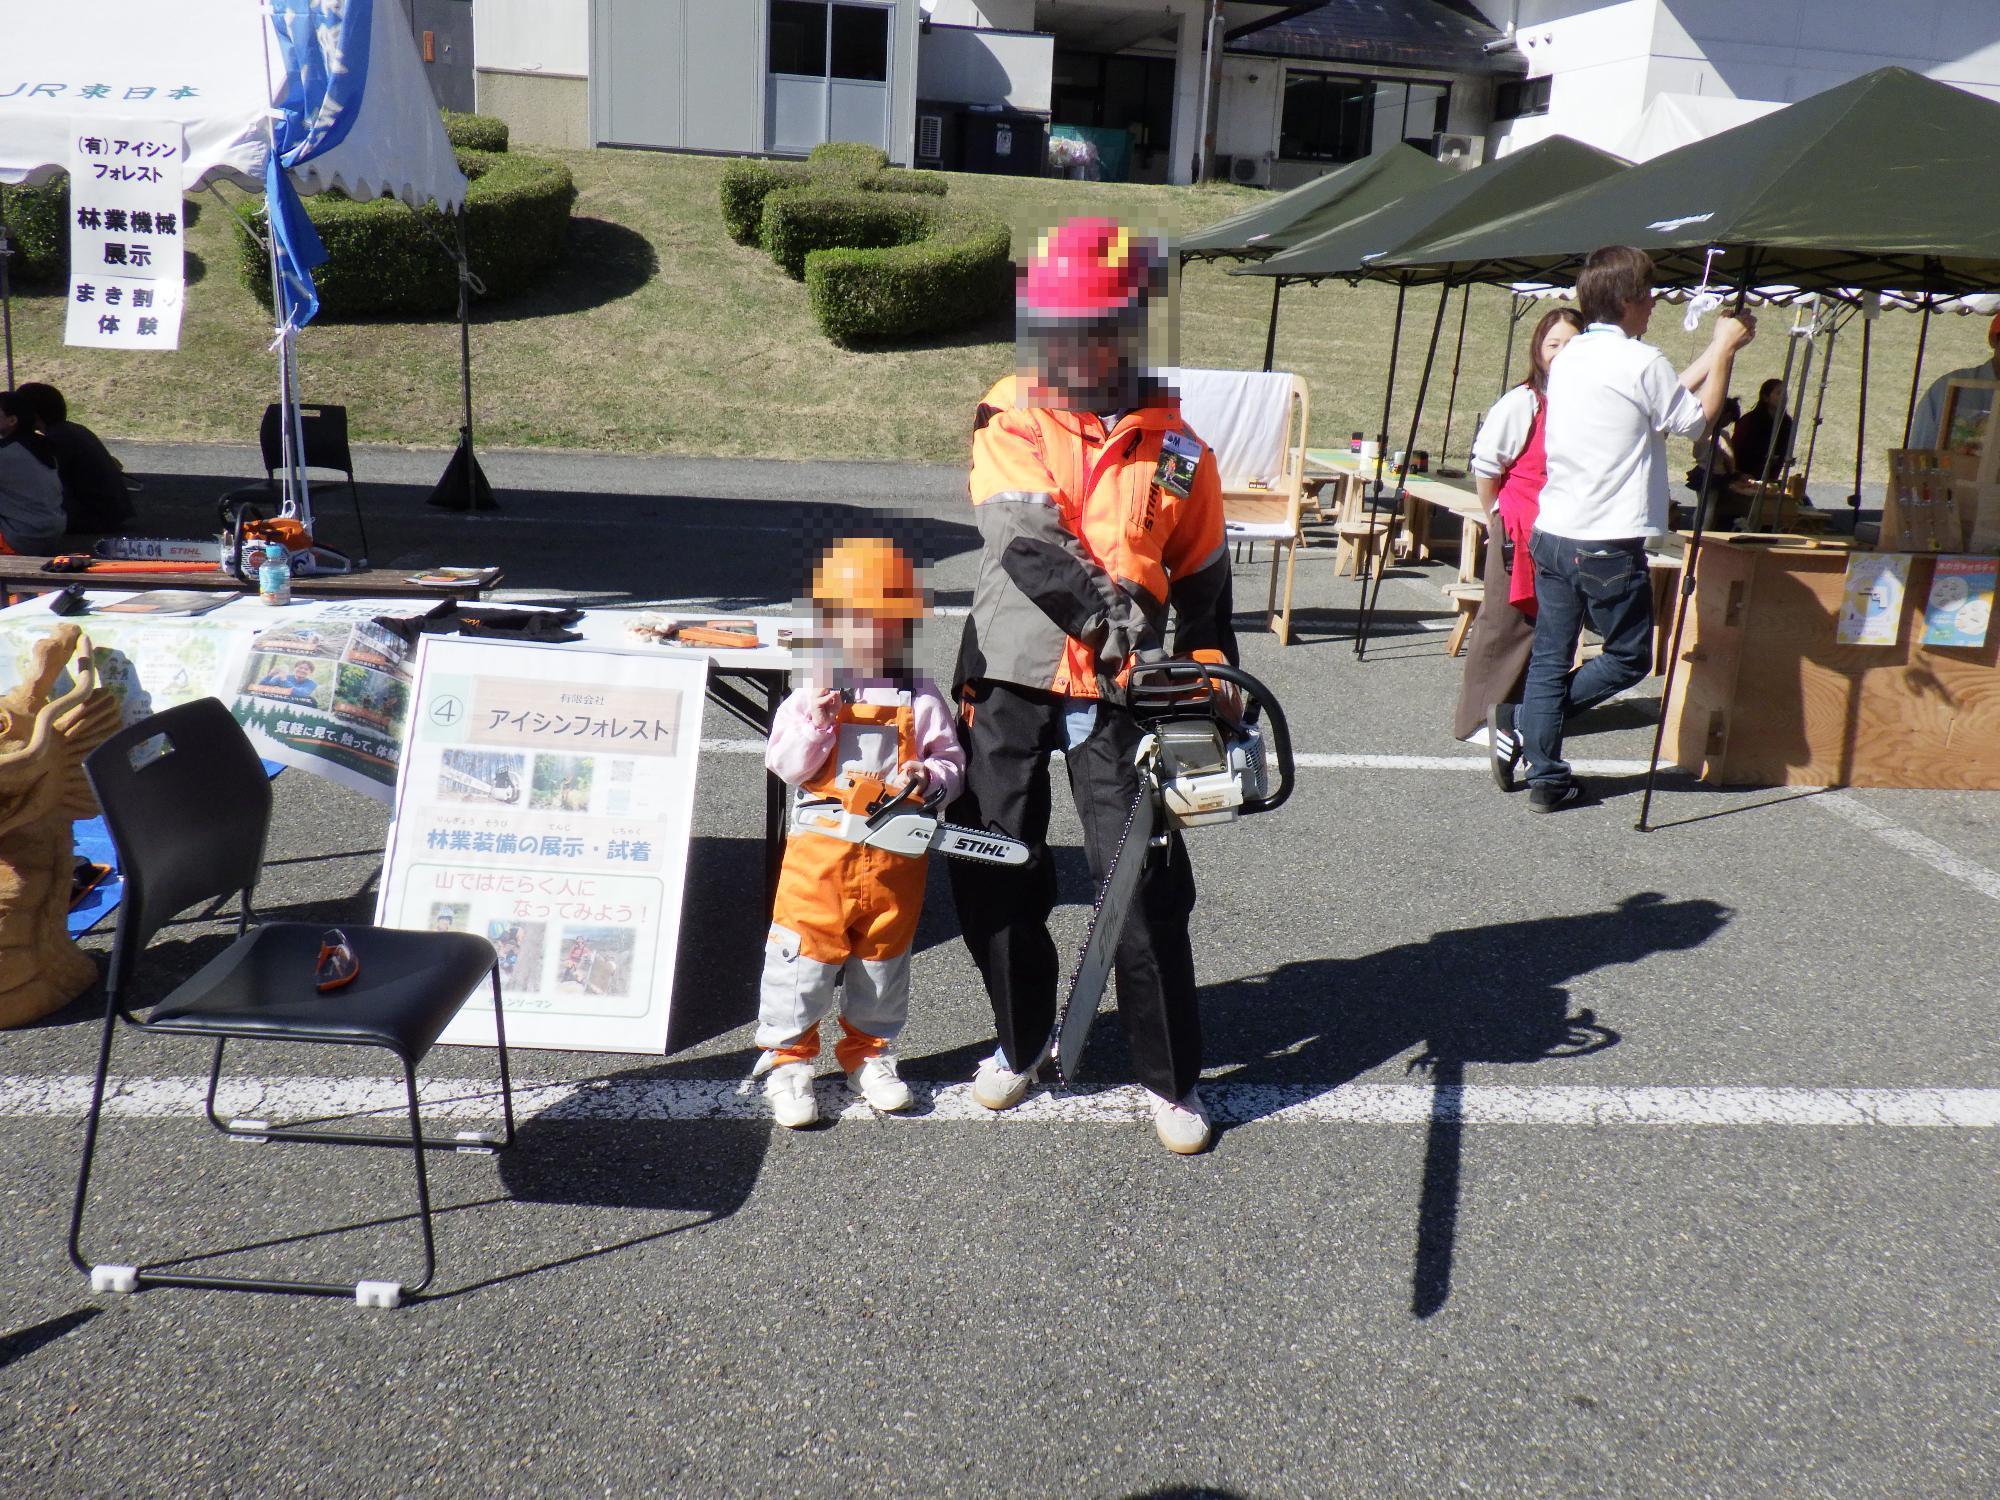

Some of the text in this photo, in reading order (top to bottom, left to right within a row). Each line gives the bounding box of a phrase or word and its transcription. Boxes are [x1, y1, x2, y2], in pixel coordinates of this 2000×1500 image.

[78, 136, 177, 158] (有)アイシン
[93, 163, 163, 183] フォレスト
[77, 207, 177, 235] 林業機械
[104, 242, 152, 267] 展示
[98, 314, 159, 336] 体験
[169, 546, 202, 556] STIHL
[488, 709, 669, 742] アイシンフォレスト
[427, 829, 652, 862] 林業装備の展示・試着
[955, 838, 1007, 858] STIHL
[435, 872, 596, 898] 山ではたらく人に
